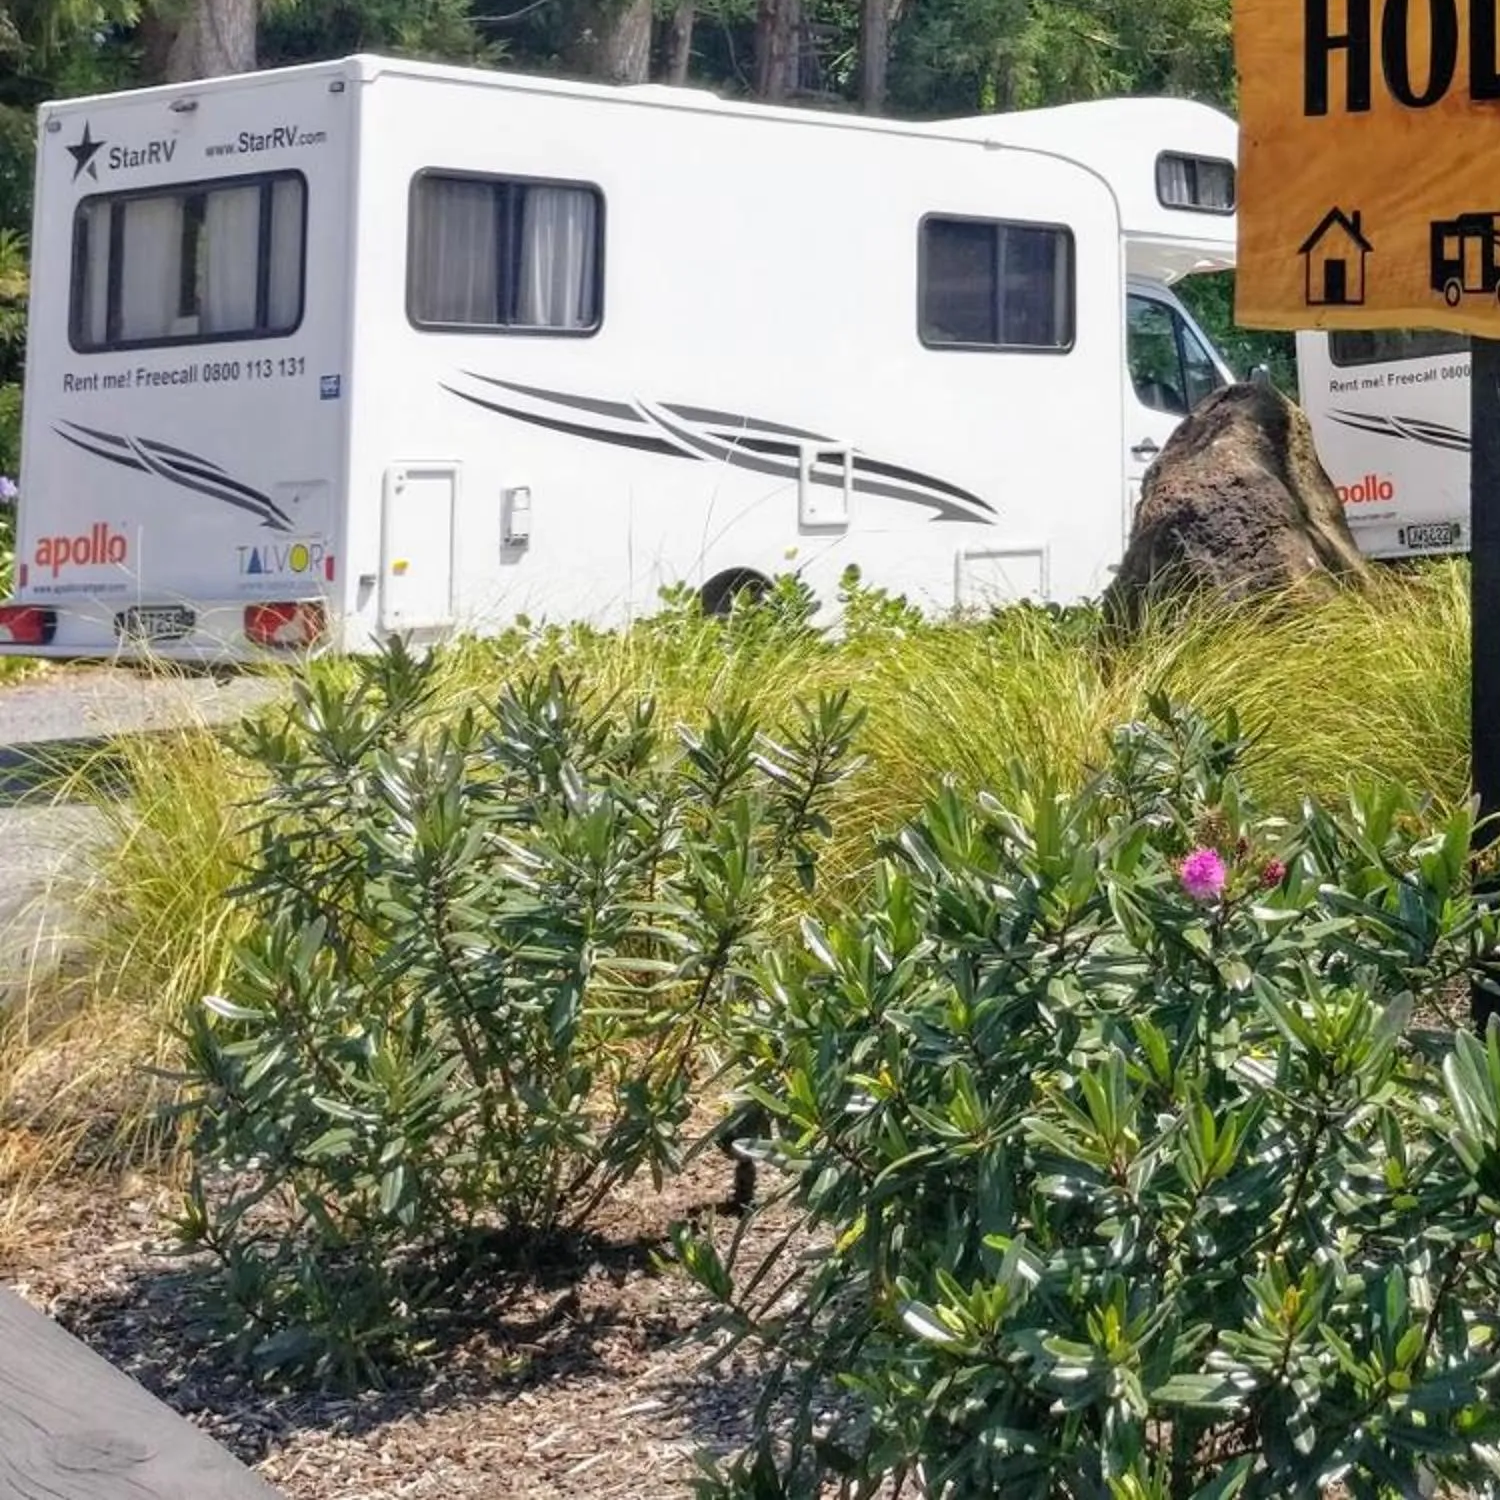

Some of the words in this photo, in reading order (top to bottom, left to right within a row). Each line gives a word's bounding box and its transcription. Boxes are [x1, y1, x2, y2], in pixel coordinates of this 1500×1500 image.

[108, 139, 177, 169] StarRV
[205, 125, 327, 157] www.StarRV.com
[63, 373, 98, 392] Rent
[103, 370, 131, 389] me!
[136, 365, 198, 388] Freecall
[203, 361, 240, 383] 0800
[247, 359, 273, 379] 113
[279, 357, 305, 377] 131
[1329, 380, 1358, 393] Rent
[1361, 376, 1384, 389] me!
[1387, 369, 1437, 386] Freecall
[1334, 474, 1393, 503] pollo
[35, 522, 127, 578] apollo
[235, 543, 324, 575] TALVOR
